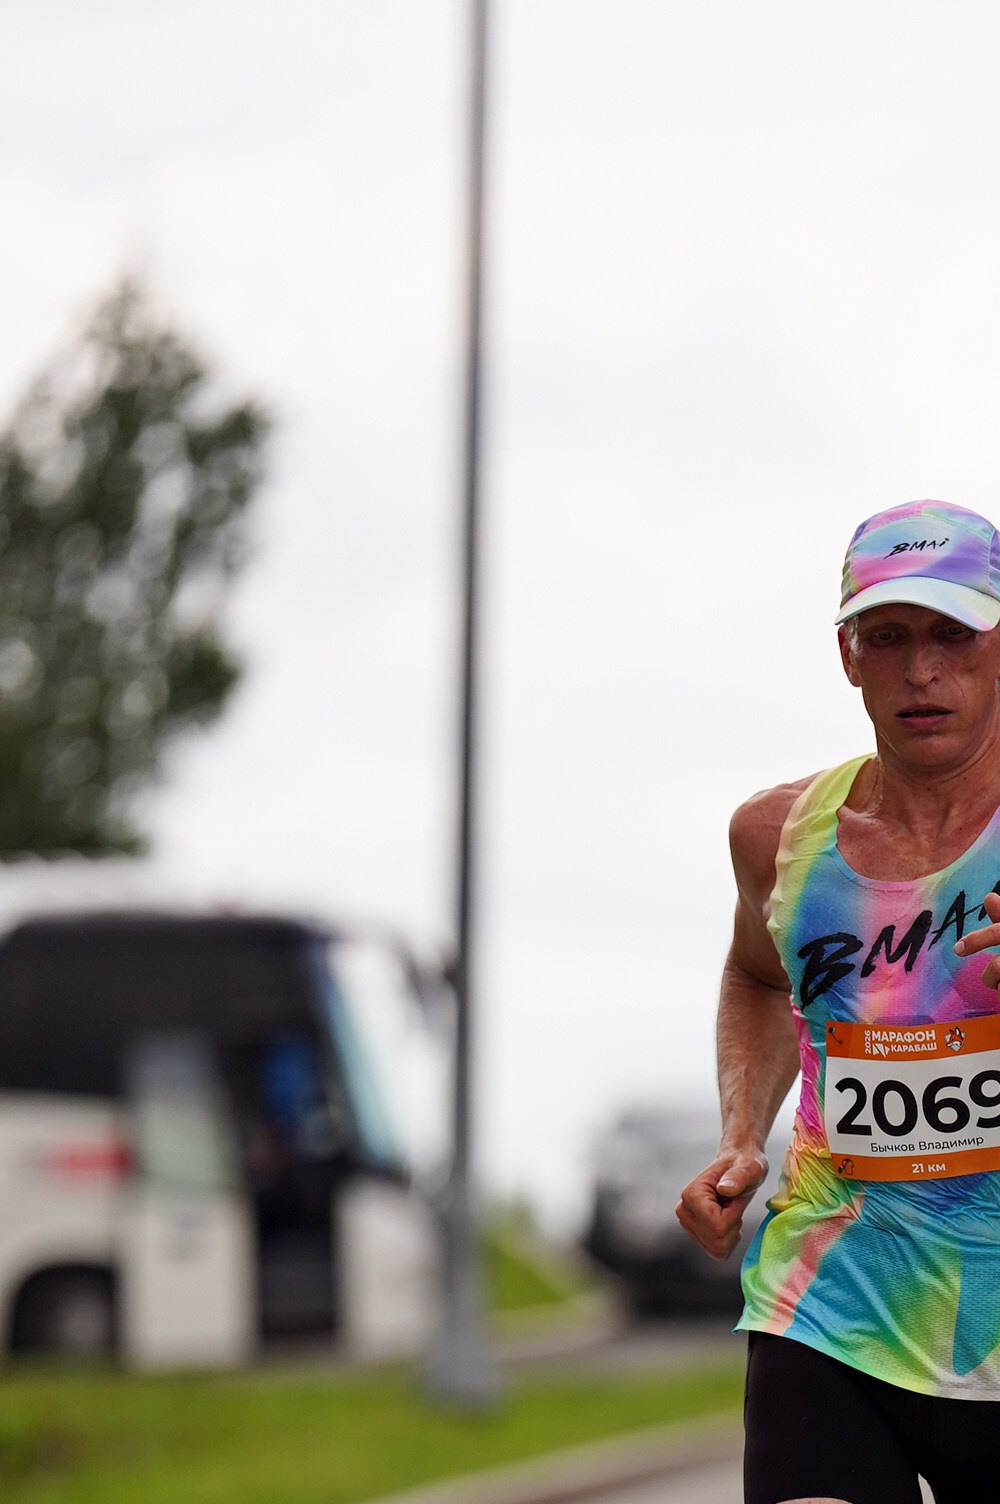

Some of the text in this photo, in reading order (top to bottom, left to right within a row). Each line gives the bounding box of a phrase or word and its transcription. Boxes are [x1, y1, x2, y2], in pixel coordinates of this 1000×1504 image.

[864, 1030, 872, 1054] 2026
[871, 1029, 936, 1043] МАРАФОН
[890, 1042, 938, 1053] КАРАБАШ
[870, 1137, 984, 1152] Бычков Владимир
[912, 1163, 924, 1174] 21
